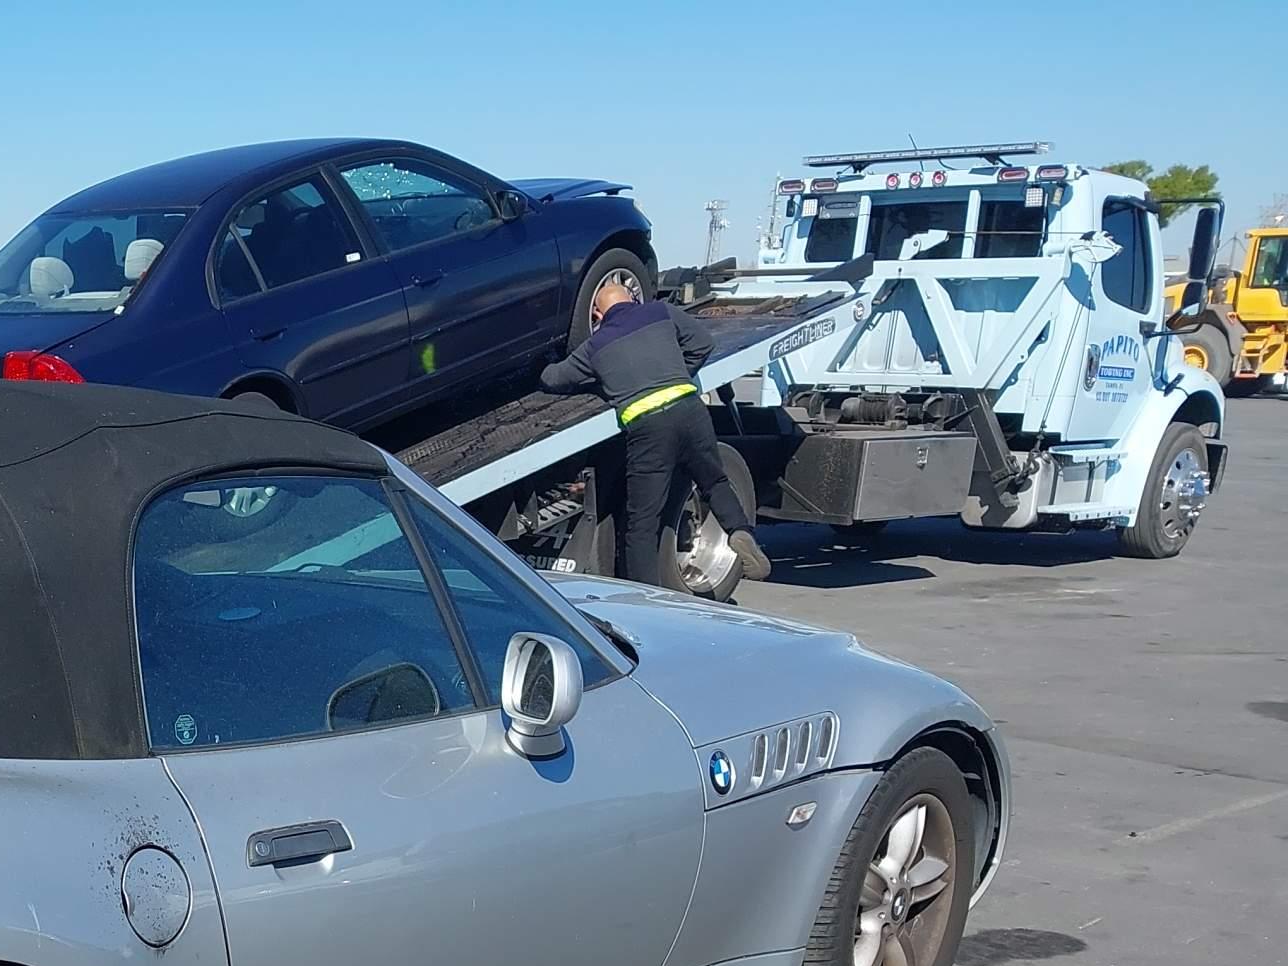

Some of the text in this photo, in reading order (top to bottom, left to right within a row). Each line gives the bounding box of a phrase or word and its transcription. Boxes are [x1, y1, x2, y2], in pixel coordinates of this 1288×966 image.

[771, 320, 834, 358] FREIGHTLINER
[1101, 335, 1139, 362] PAPITO
[1100, 367, 1123, 378] TOWING
